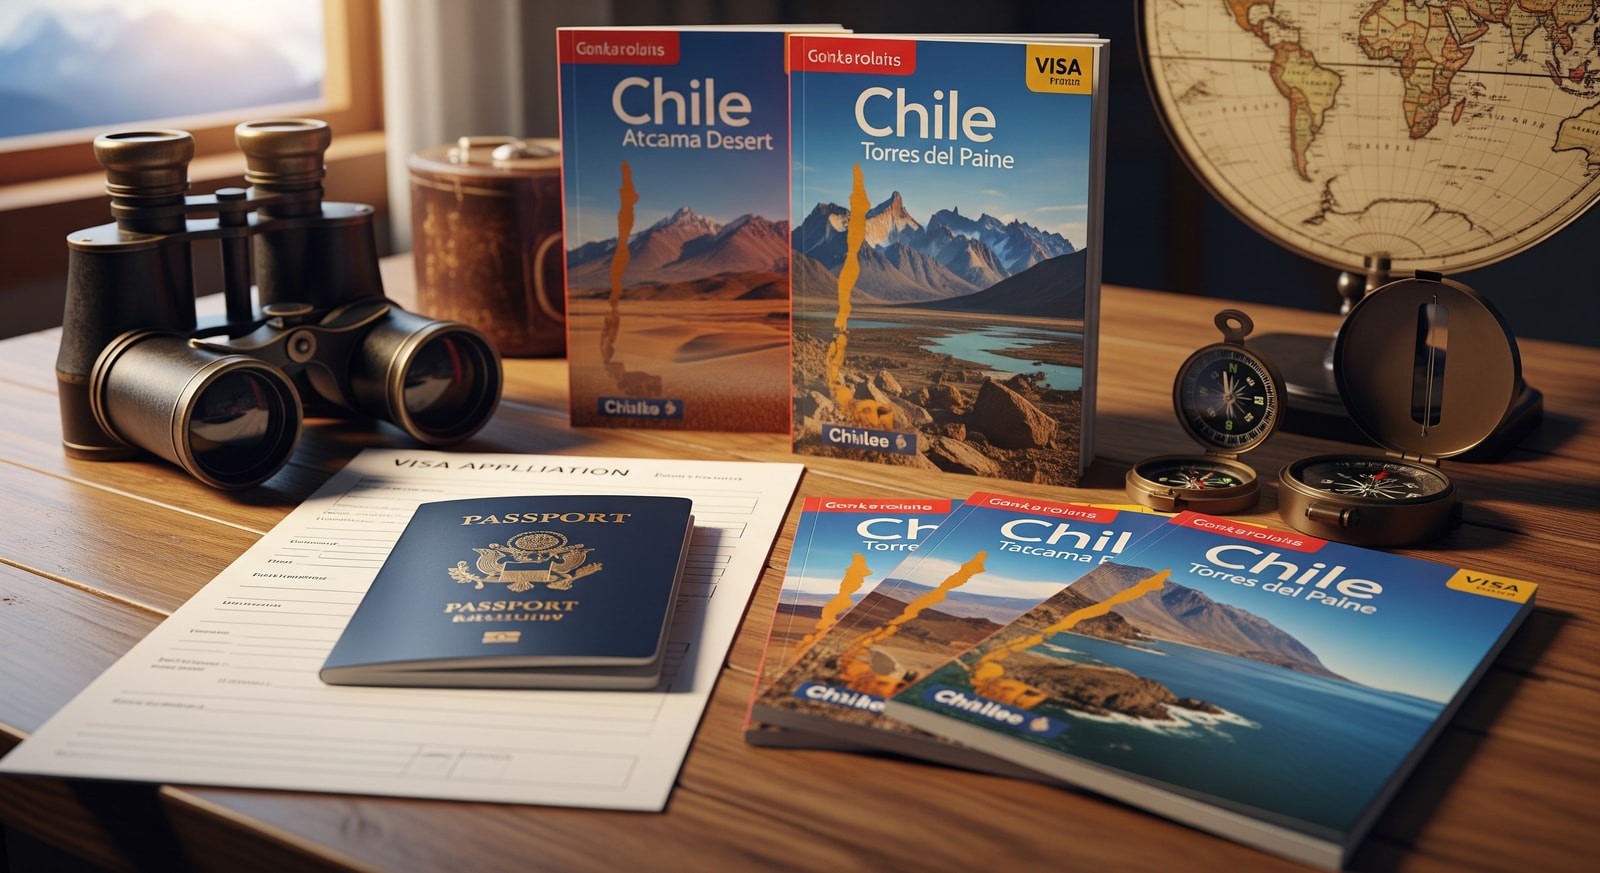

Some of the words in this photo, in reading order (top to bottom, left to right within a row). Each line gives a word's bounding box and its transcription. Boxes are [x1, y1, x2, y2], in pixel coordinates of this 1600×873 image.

[1035, 56, 1082, 76] VISA
[611, 76, 753, 127] Chile
[854, 86, 997, 143] Chile
[622, 128, 702, 149] Atcama
[706, 131, 775, 151] Desert
[860, 141, 920, 164] Torres
[923, 145, 954, 166] del
[959, 147, 1016, 170] Paine
[394, 457, 451, 470] VISA
[460, 512, 633, 527] PASSPORT
[856, 517, 940, 540] Ch
[862, 540, 921, 552] Torre
[1000, 518, 1133, 554] Chil
[1205, 544, 1384, 600] Chile
[1188, 562, 1258, 588] Torres
[1260, 582, 1301, 600] del
[1305, 590, 1378, 616] Paine
[1466, 575, 1519, 593] VISA
[443, 599, 580, 614] PASSPORT
